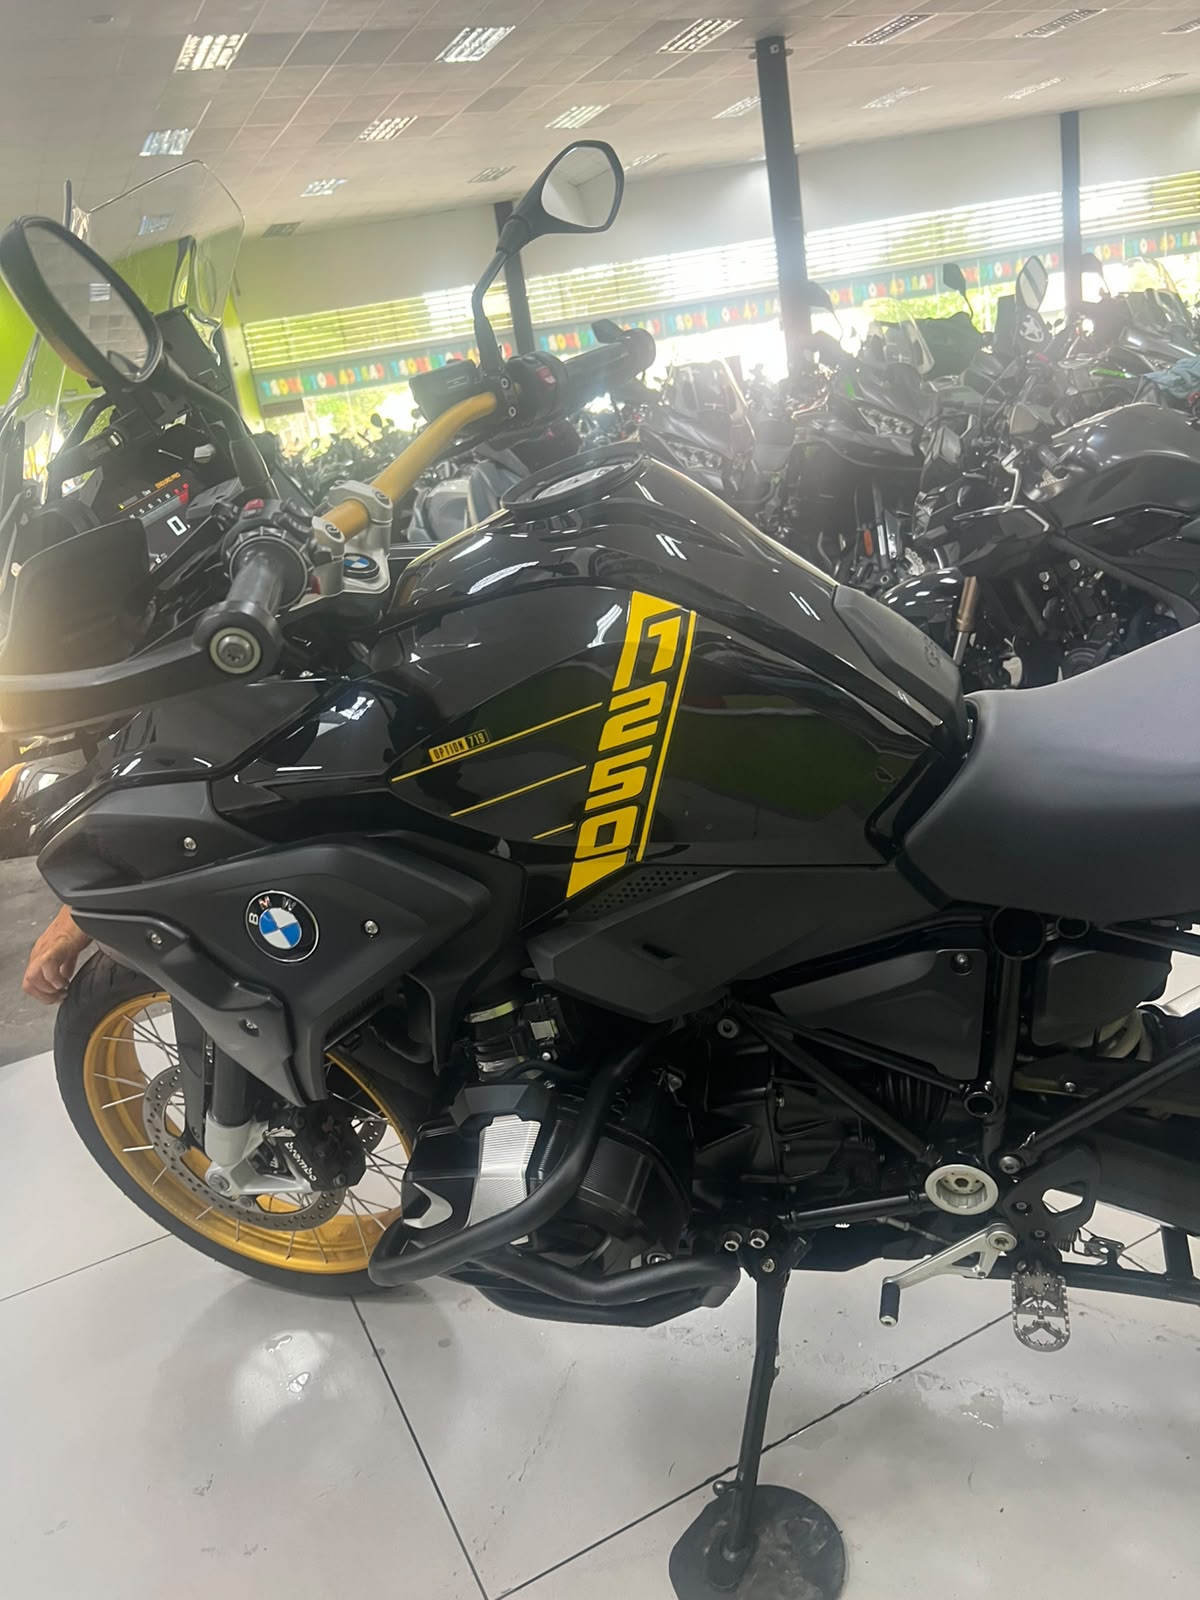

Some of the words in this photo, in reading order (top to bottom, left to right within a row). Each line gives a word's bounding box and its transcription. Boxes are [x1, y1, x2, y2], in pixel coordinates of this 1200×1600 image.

[167, 516, 187, 536] 0
[432, 739, 466, 760] OPTION
[467, 732, 486, 748] 719
[574, 616, 682, 859] 1250
[248, 896, 297, 926] BMW
[284, 1141, 318, 1182] brembo
